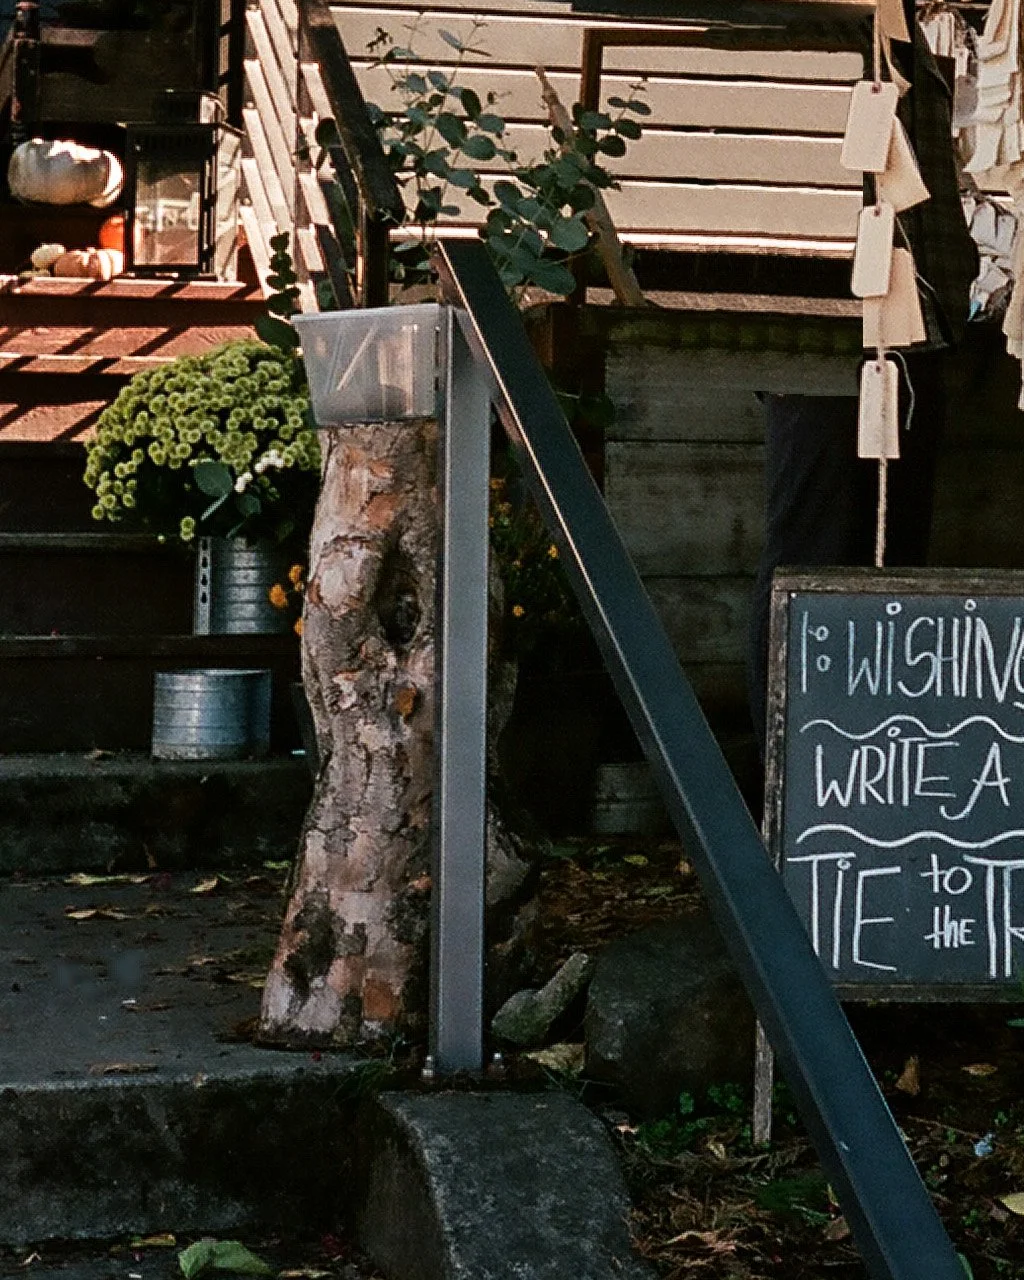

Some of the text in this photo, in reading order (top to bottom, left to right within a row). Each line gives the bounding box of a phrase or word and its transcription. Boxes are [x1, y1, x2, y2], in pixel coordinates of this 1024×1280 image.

[814, 725, 960, 808] WRITE
[940, 741, 1012, 820] A
[786, 851, 902, 972] TIE
[920, 853, 973, 894] to
